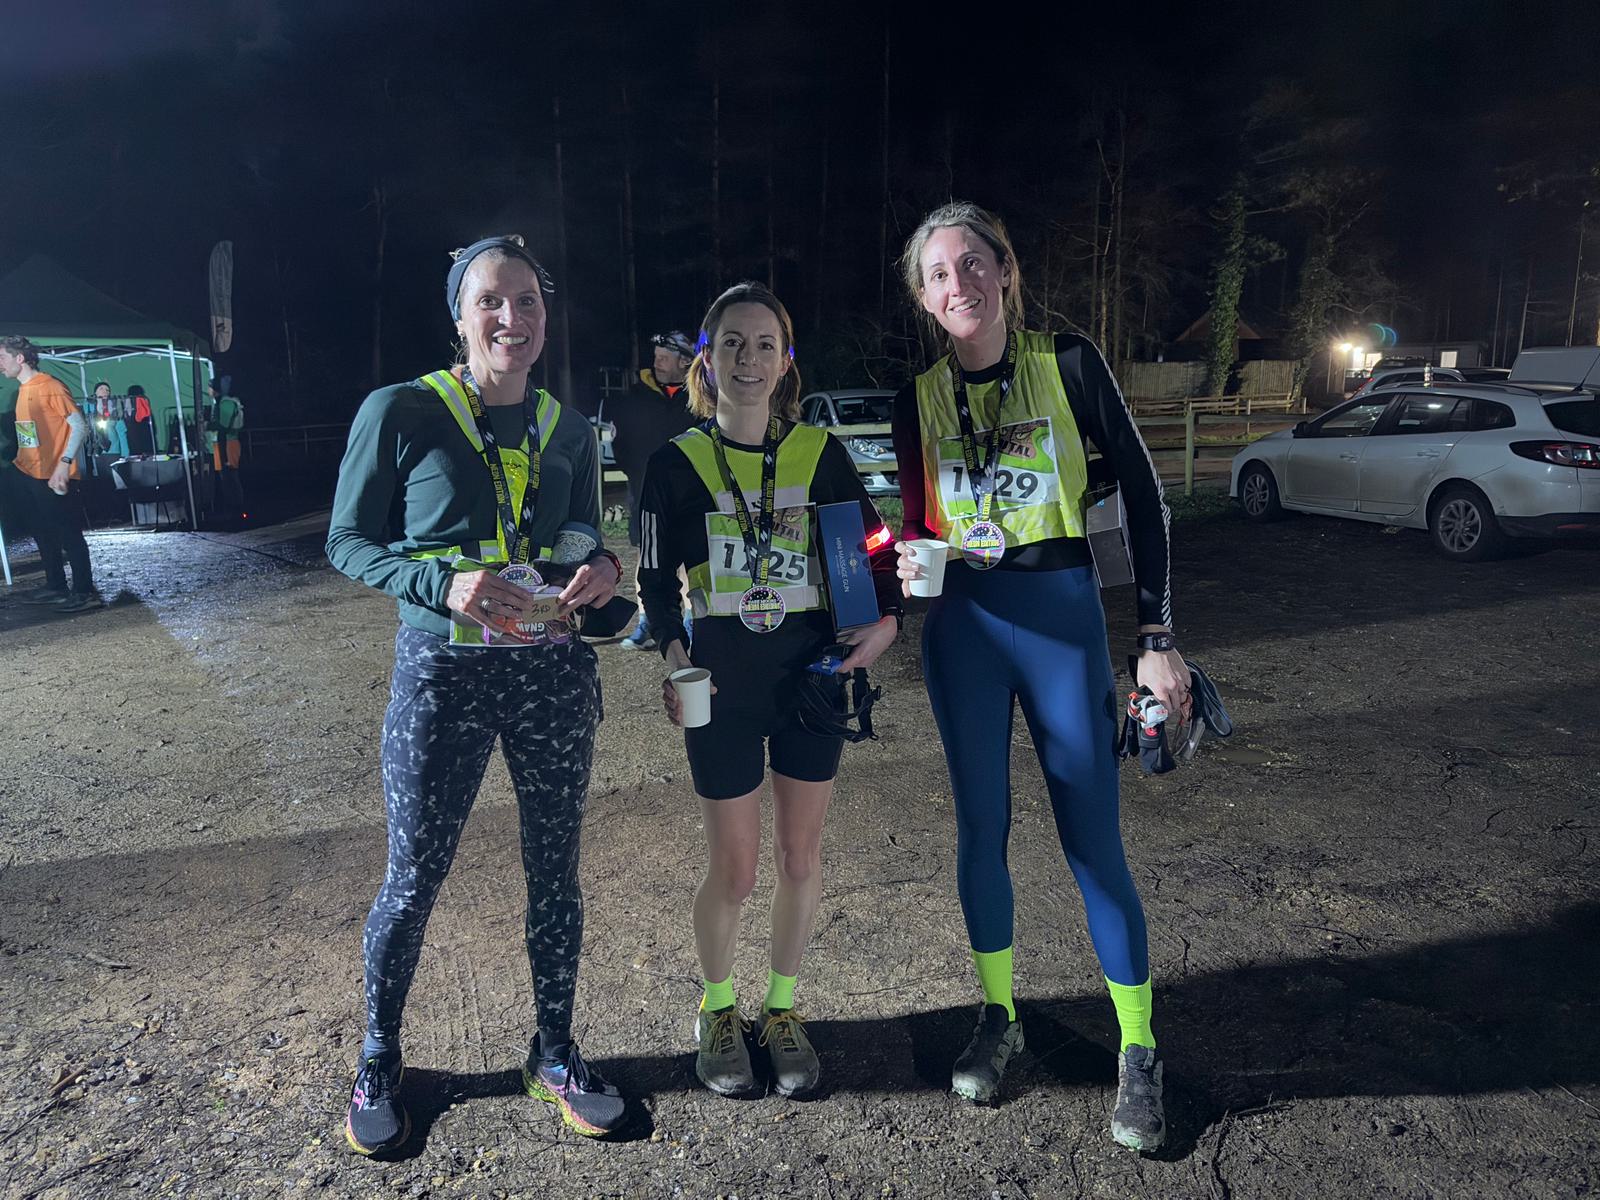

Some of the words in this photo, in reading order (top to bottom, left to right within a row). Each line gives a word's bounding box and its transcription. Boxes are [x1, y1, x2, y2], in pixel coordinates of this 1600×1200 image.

[469, 394, 484, 418] EDITION
[533, 450, 541, 475] EDITION
[965, 448, 976, 471] EDITION
[490, 463, 501, 481] NEON
[531, 473, 541, 490] NEON
[953, 466, 1039, 500] 129
[493, 478, 506, 504] EDITION
[766, 478, 775, 499] EDITION
[734, 497, 744, 513] NEON
[765, 498, 774, 513] NEON
[737, 511, 749, 533] EDITION
[753, 516, 801, 541] BUTAL
[519, 537, 530, 560] EDITION
[835, 537, 844, 550] MINI
[723, 543, 806, 581] 125
[760, 558, 770, 580] EDITION
[838, 550, 849, 579] MASSAGE
[843, 579, 851, 593] GUN
